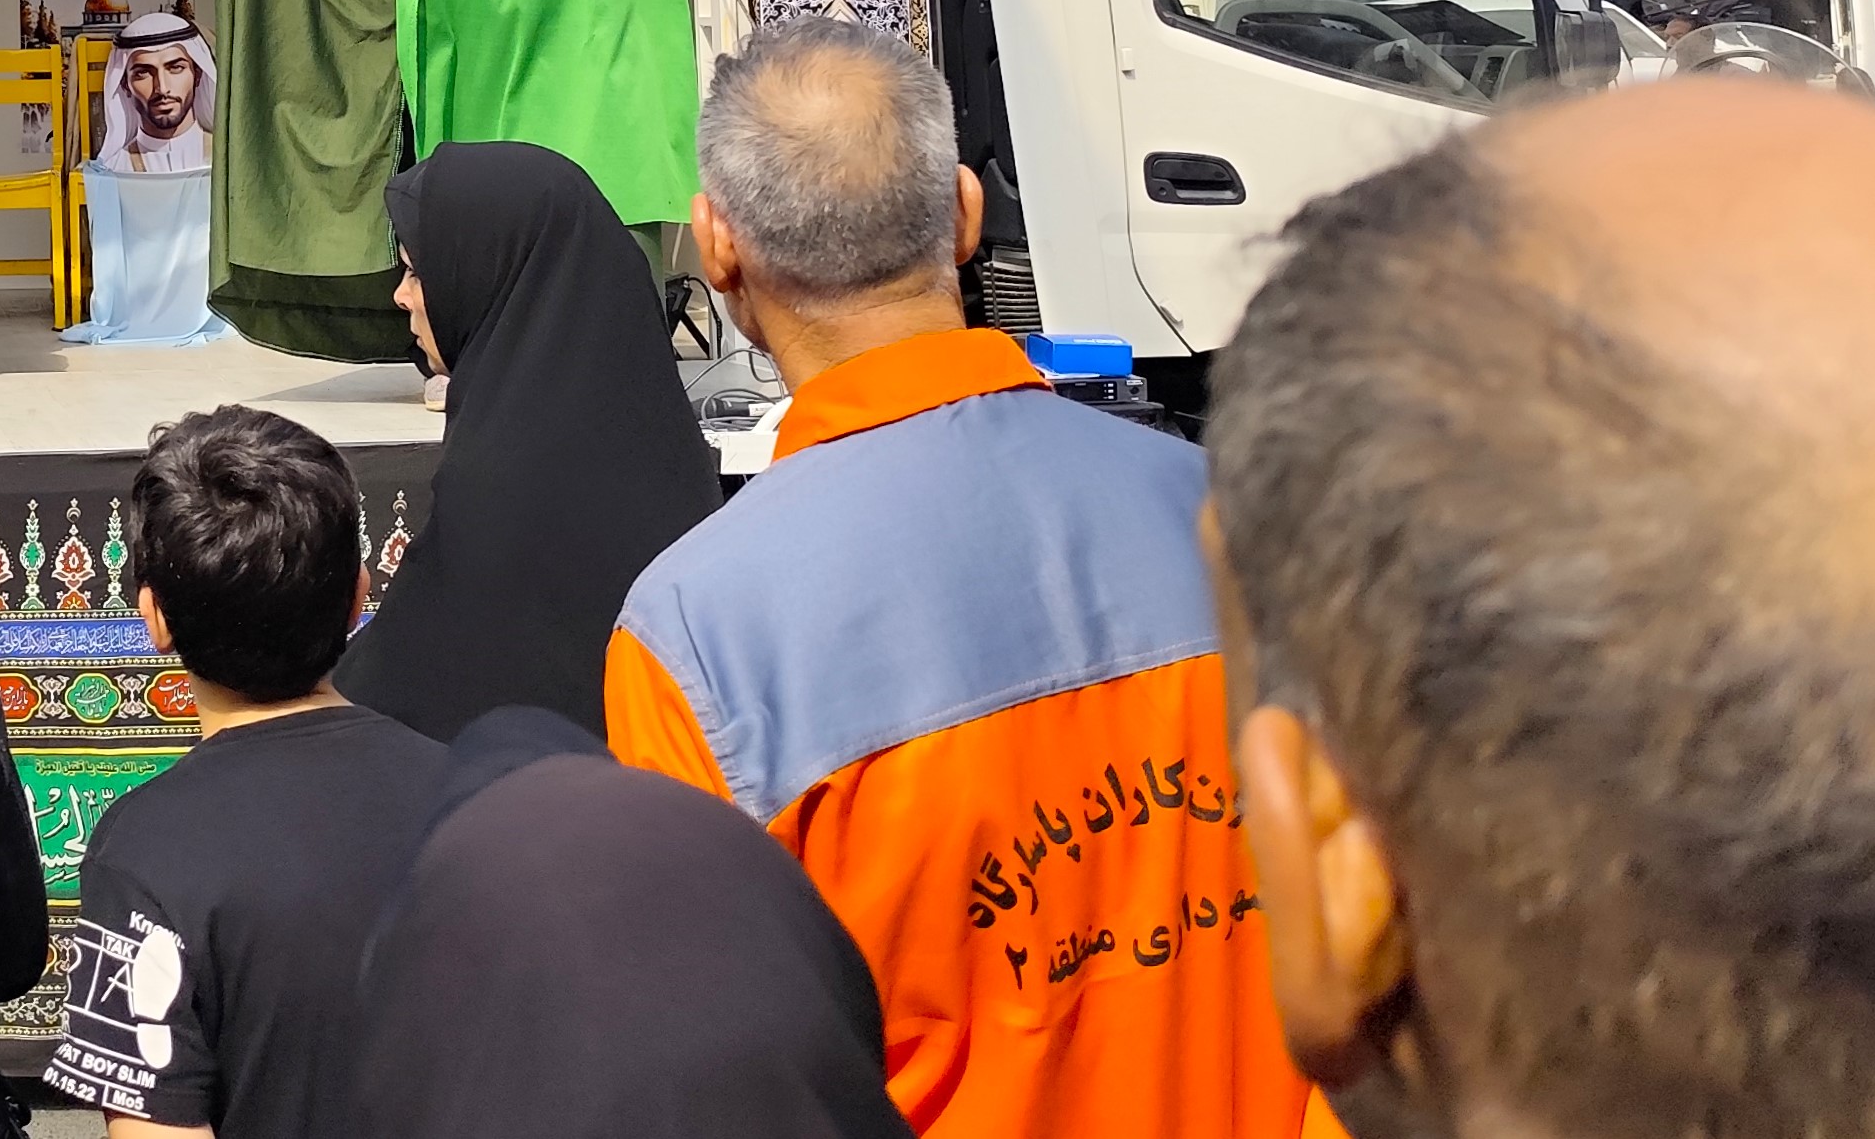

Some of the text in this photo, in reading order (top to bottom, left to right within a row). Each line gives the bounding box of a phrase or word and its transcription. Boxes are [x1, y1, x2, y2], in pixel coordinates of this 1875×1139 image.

[1132, 886, 1264, 967] هرداری
[43, 1066, 145, 1111] 01.15.22 Mo5
[80, 1052, 118, 1076] BOY
[117, 1064, 157, 1090] SLIM
